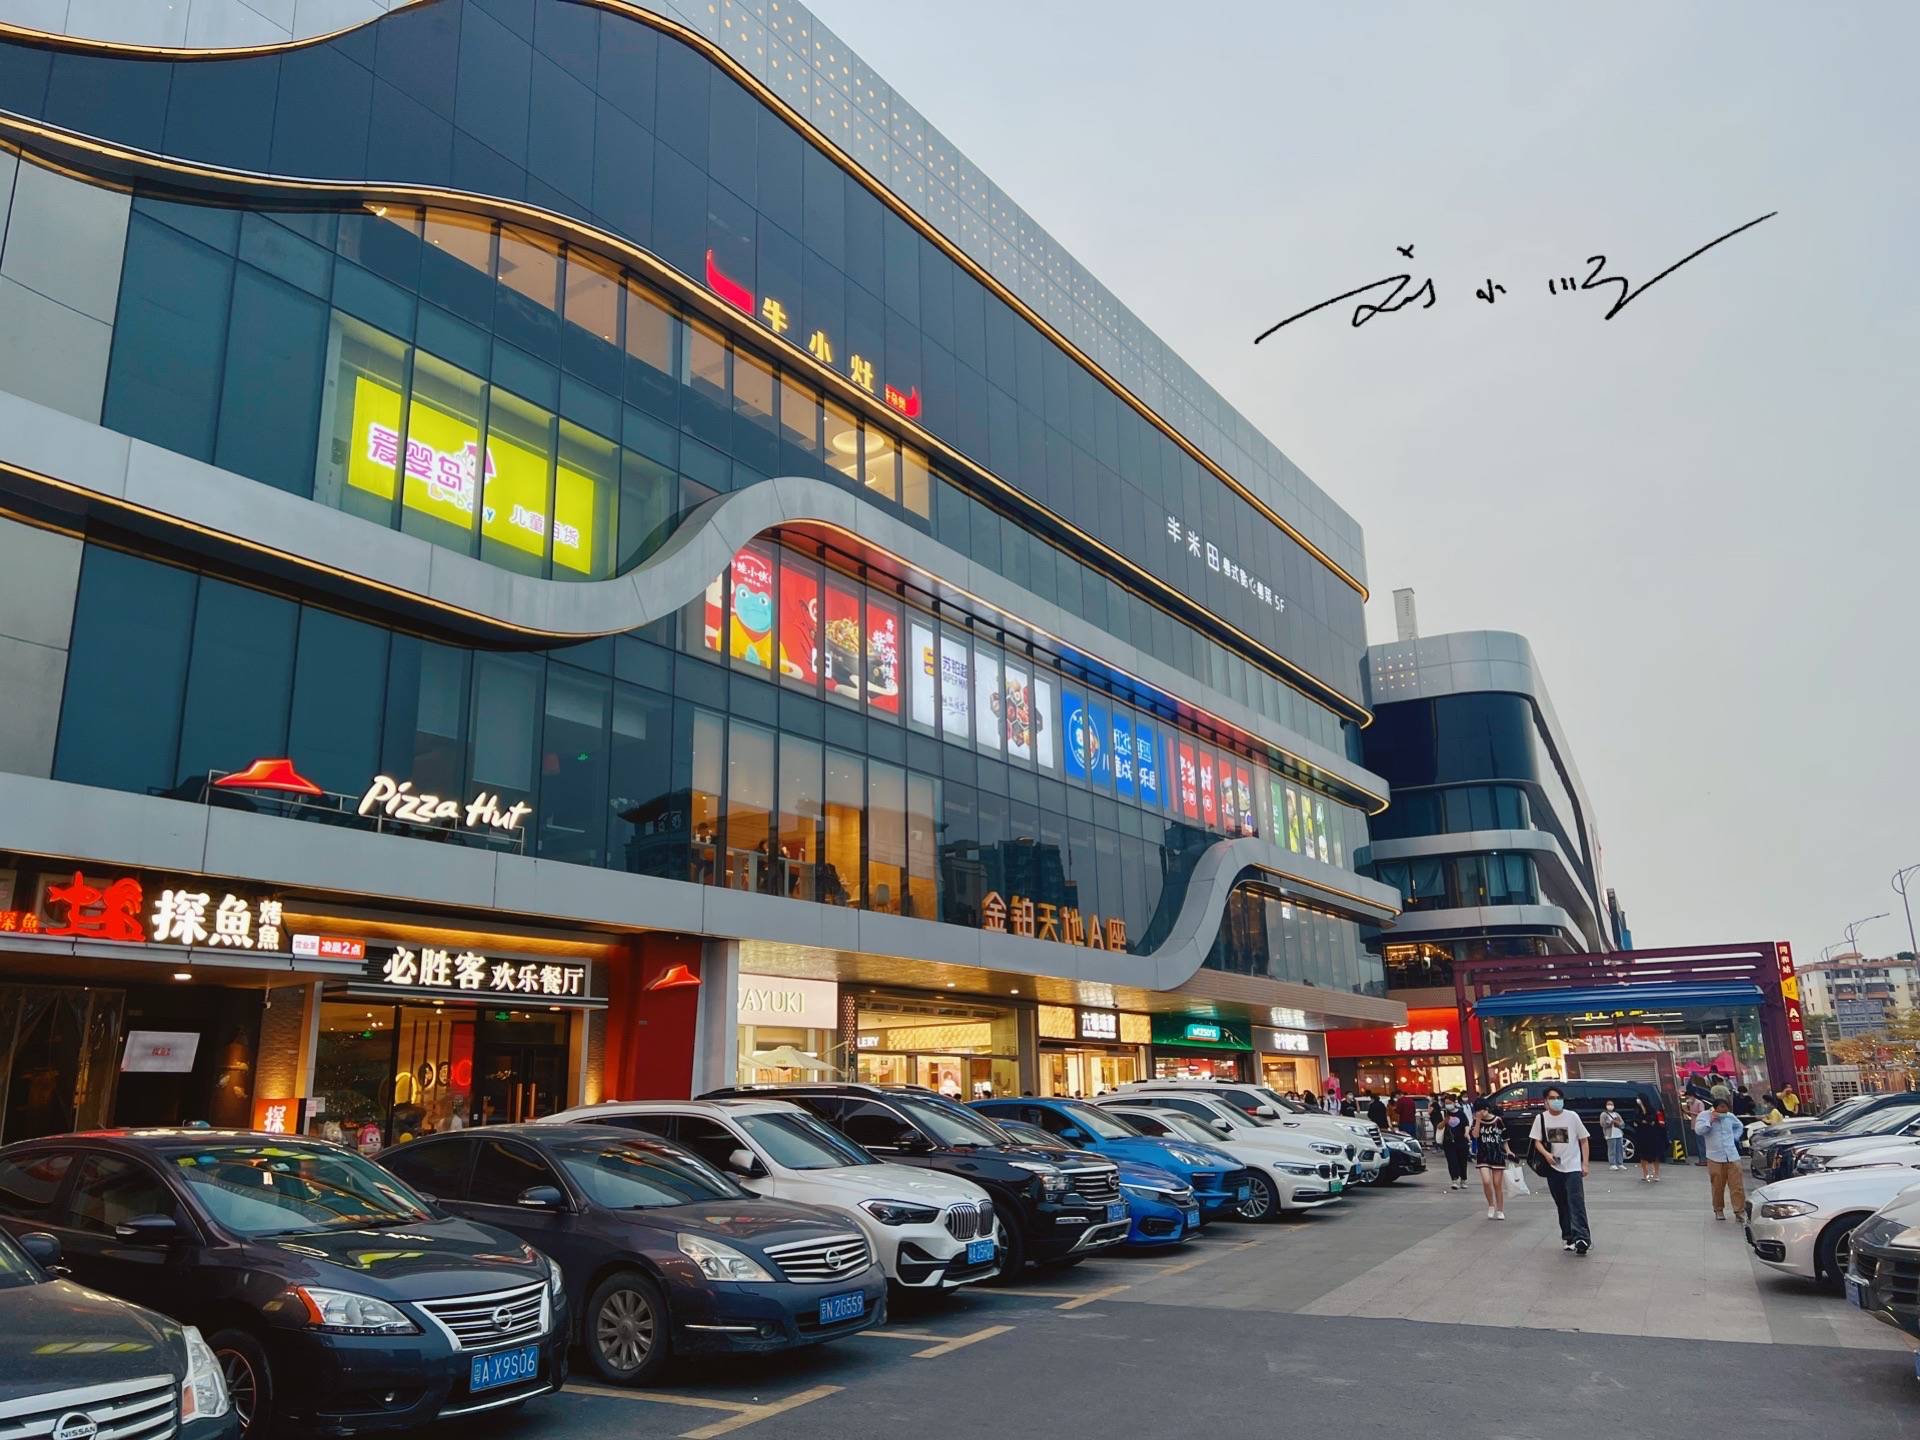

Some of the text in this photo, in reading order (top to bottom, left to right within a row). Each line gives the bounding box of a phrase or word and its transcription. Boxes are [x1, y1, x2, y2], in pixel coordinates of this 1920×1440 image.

[762, 296, 875, 394] 牛小灶
[357, 774, 533, 830] Pizza Hut
[382, 945, 585, 995] 必胜客 欢乐餐厅
[740, 987, 807, 1015] AYUKI
[1789, 1007, 1800, 1018] A
[60, 1425, 96, 1439] NISSAN
